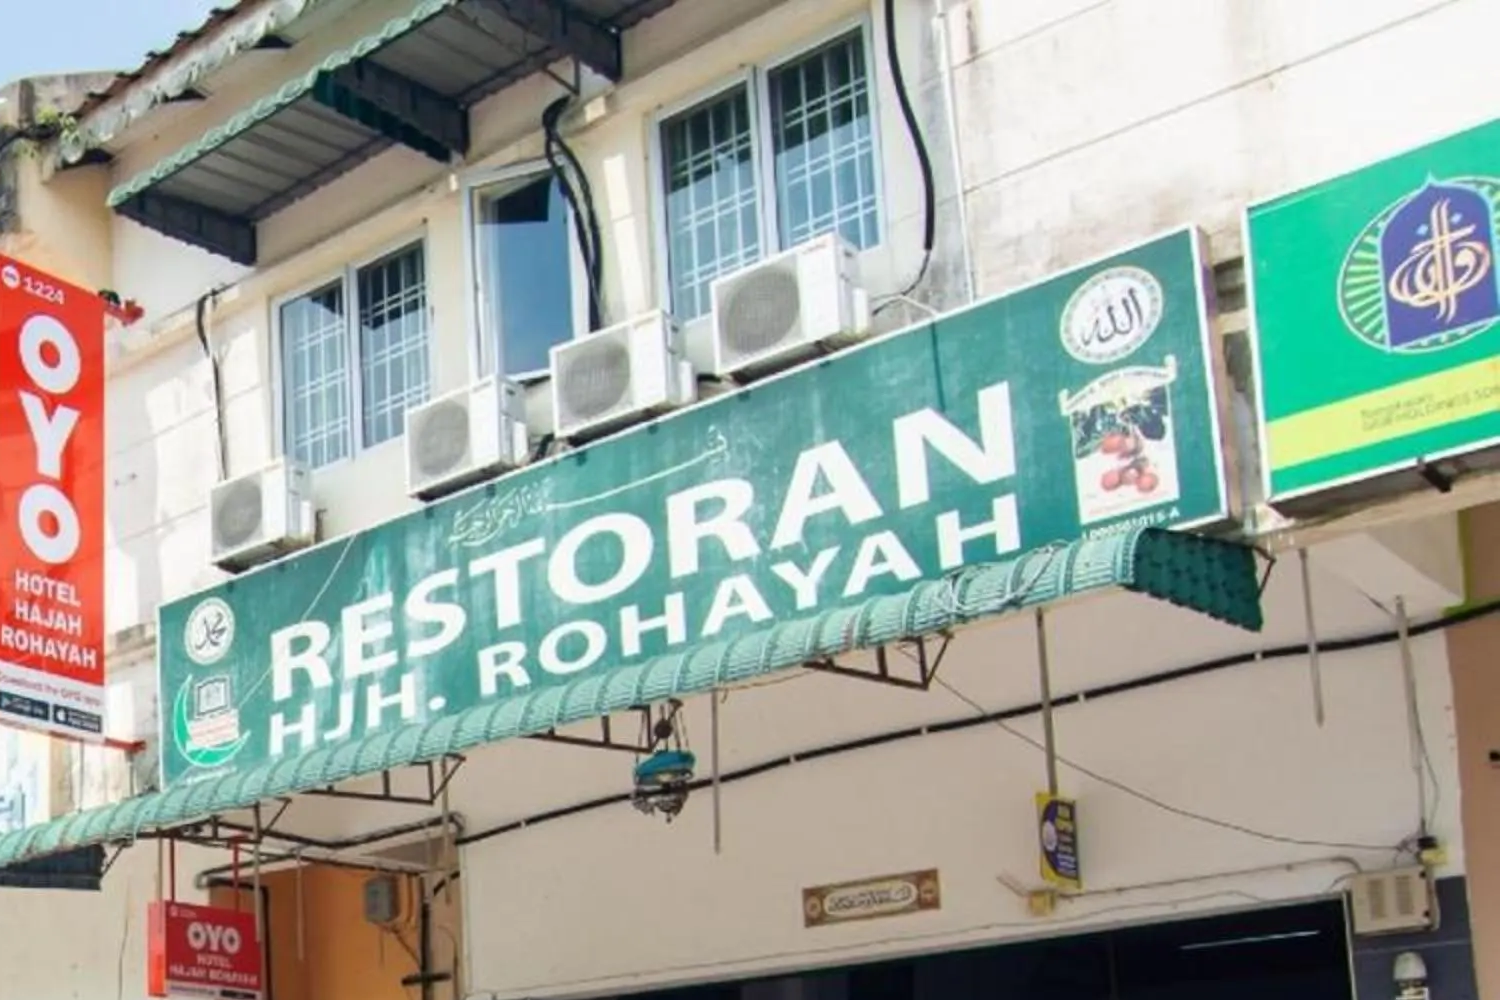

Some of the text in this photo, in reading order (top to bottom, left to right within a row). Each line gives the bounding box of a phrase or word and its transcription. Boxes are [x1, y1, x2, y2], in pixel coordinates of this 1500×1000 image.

[18, 313, 82, 564] OYO
[270, 380, 1017, 702] RESTORAN
[15, 569, 82, 608] HOTEL
[15, 598, 83, 638] HAJAH
[269, 493, 1021, 756] HJH. ROHAYAH
[0, 623, 97, 671] ROHAYAH
[187, 921, 241, 954] OYO
